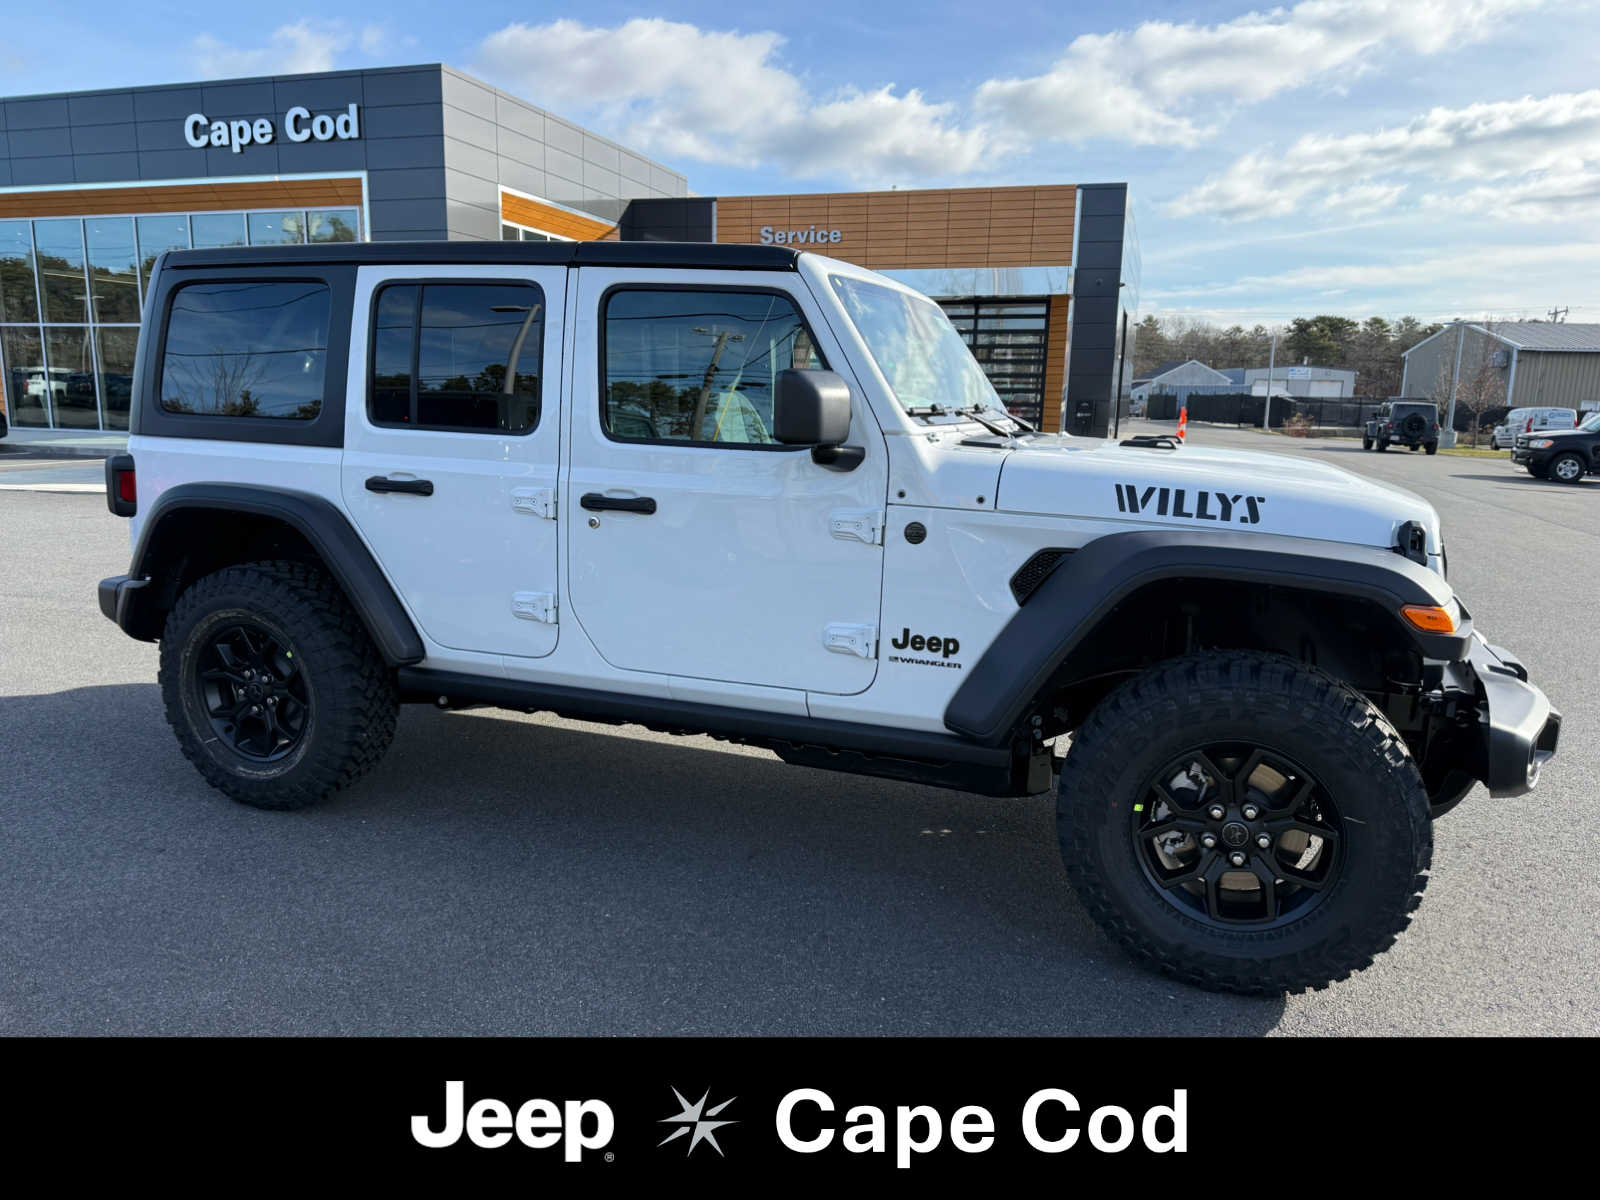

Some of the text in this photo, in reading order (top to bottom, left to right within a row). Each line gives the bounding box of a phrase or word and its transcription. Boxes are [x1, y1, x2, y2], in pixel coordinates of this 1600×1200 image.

[184, 103, 359, 153] Cape Cod
[760, 225, 842, 246] Service
[1114, 483, 1266, 525] WILLYS
[891, 627, 961, 659] Jeep
[900, 656, 962, 670] WRANGLER
